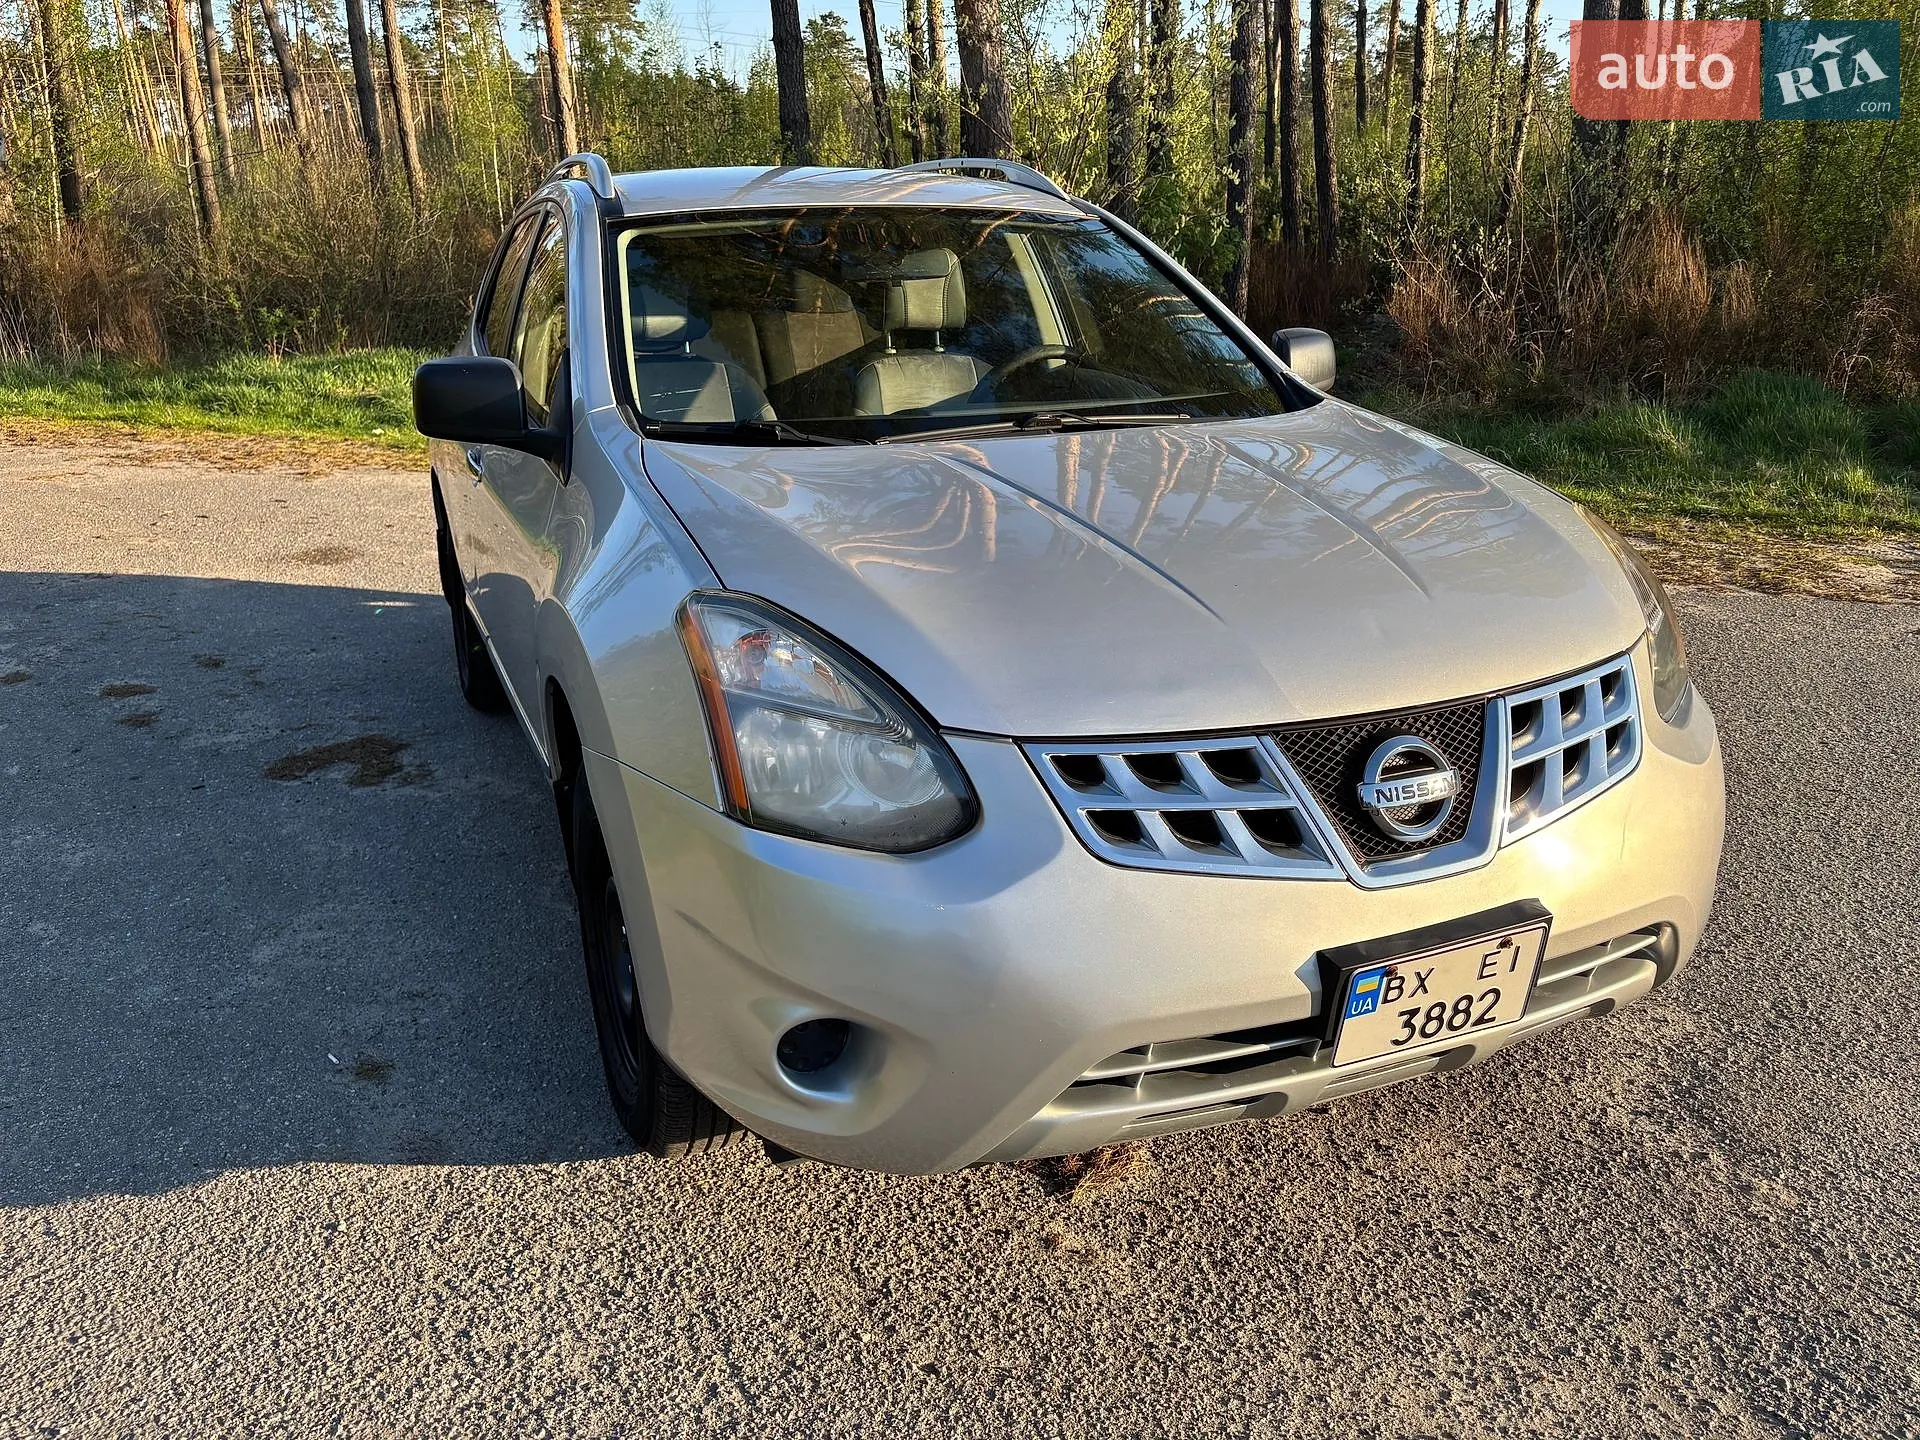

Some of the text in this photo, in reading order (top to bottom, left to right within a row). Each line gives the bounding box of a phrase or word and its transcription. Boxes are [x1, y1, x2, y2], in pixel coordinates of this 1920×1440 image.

[1375, 775, 1456, 804] NISSAN
[1381, 967, 1435, 1005] BX
[1351, 997, 1373, 1015] UA
[1390, 987, 1502, 1047] 3882
